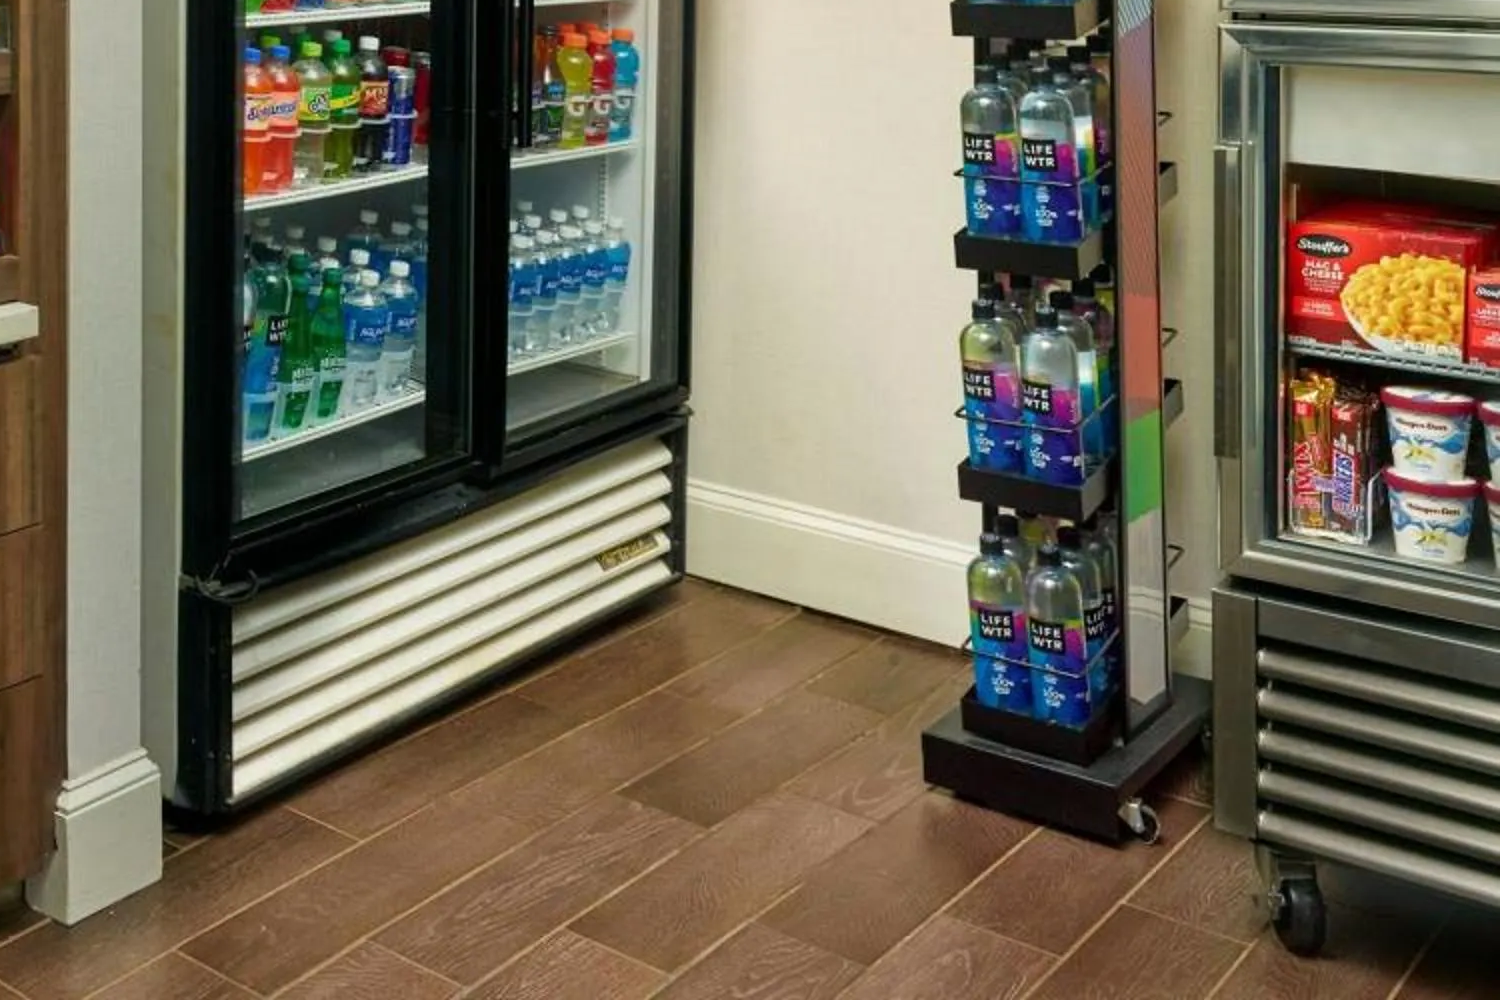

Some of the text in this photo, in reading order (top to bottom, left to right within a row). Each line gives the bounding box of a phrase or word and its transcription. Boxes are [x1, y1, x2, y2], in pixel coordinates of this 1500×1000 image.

[964, 136, 992, 150] LIFE
[1023, 143, 1054, 156] LIFE
[965, 149, 995, 161] WTR
[1025, 155, 1056, 168] WTR
[1297, 237, 1350, 255] Stouffer's
[1301, 268, 1344, 281] CHEESE
[965, 385, 993, 397] WTR
[1024, 398, 1051, 411] WTR
[980, 614, 1011, 627] LIFE
[981, 625, 1013, 638] WTR
[1031, 623, 1062, 638] LIFE
[1033, 637, 1064, 650] WTR
